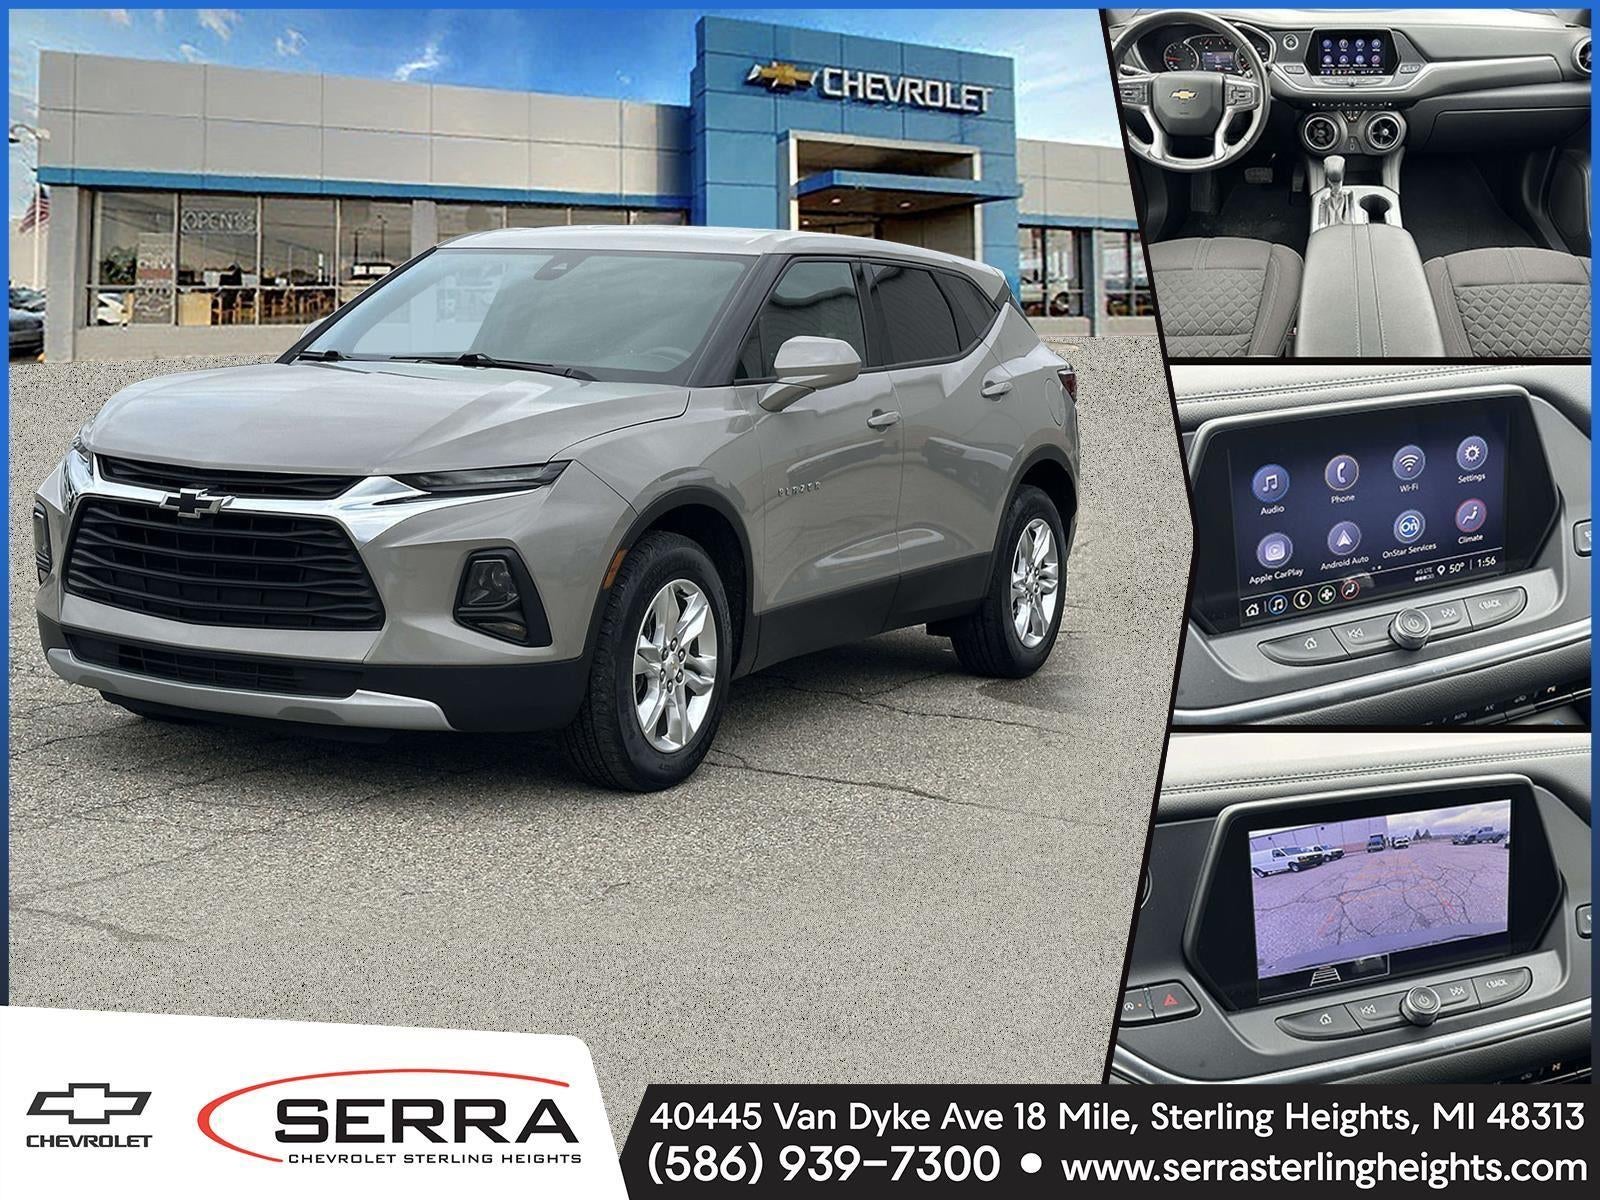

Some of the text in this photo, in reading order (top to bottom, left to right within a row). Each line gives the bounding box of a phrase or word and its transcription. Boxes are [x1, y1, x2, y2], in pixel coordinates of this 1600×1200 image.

[822, 66, 993, 113] CHEVROLET
[1457, 473, 1486, 485] Settings
[1399, 483, 1419, 493] Wi-Fi
[1330, 494, 1356, 504] Phone
[1260, 505, 1285, 515] Audio
[1457, 534, 1484, 544] Climate
[1382, 543, 1437, 559] OnStar Services
[1320, 555, 1370, 571] Android Auto
[1477, 556, 1497, 567] 1:56
[1249, 567, 1304, 585] Apple CarPlay
